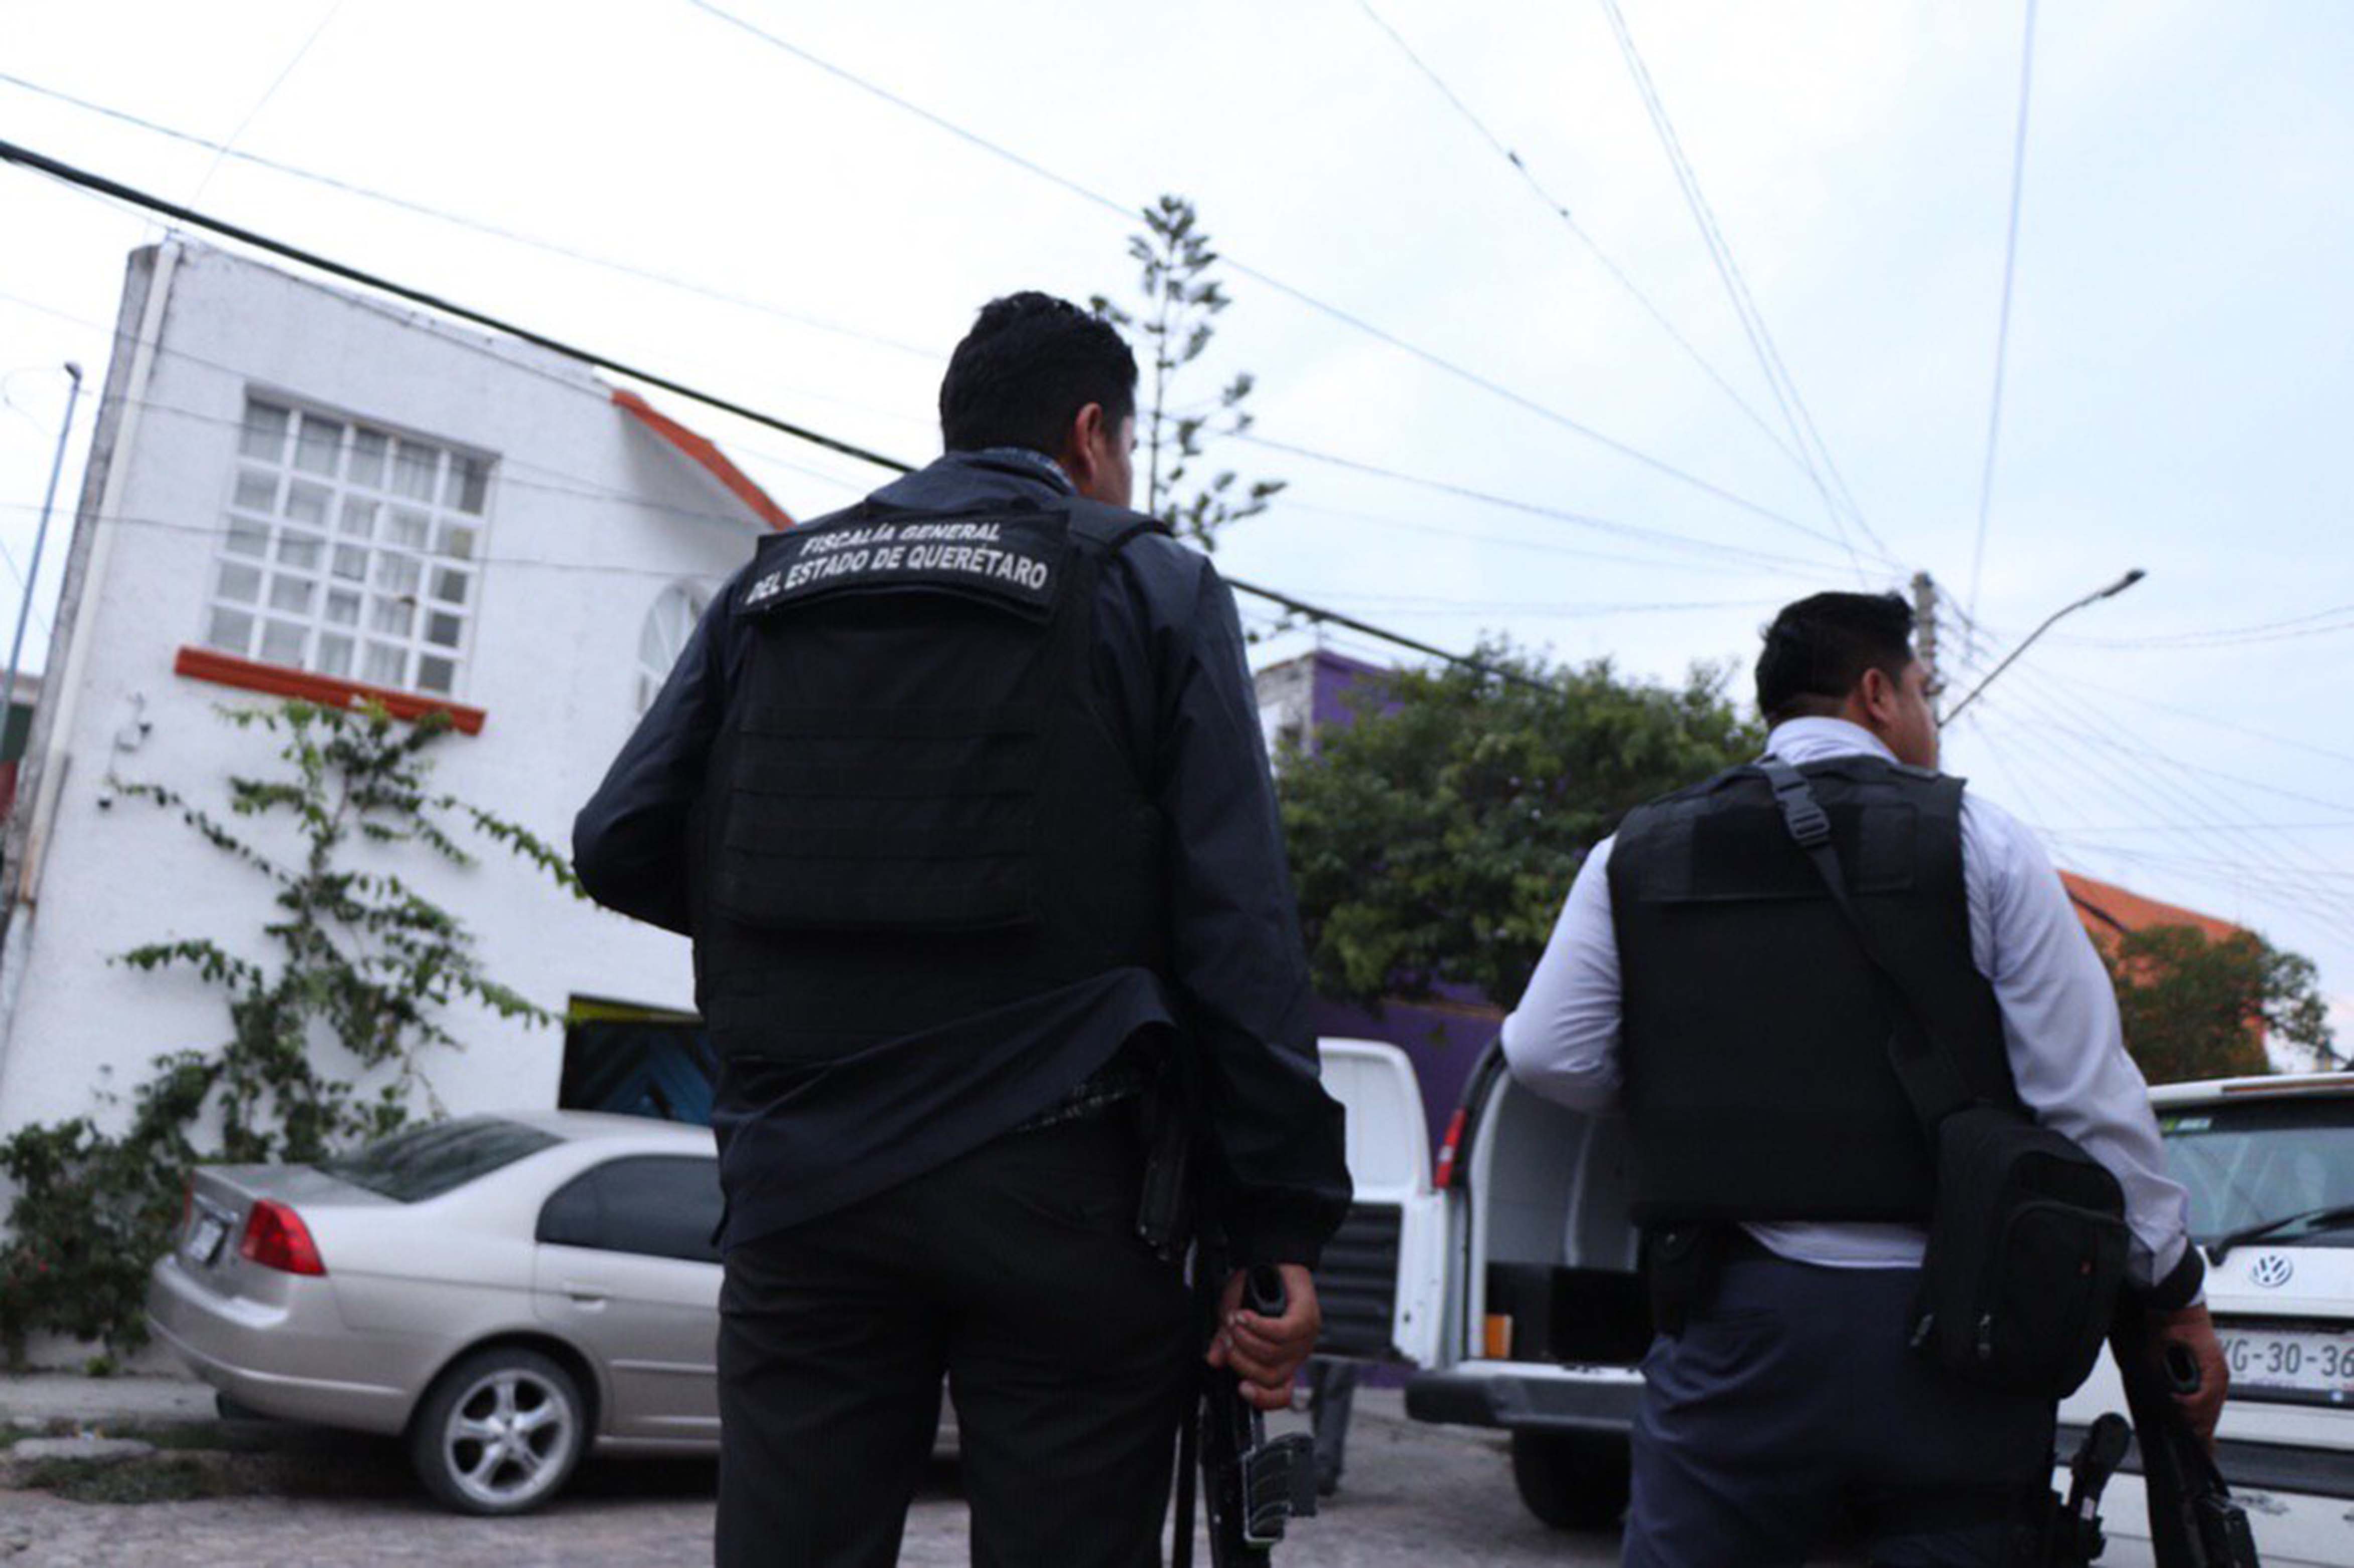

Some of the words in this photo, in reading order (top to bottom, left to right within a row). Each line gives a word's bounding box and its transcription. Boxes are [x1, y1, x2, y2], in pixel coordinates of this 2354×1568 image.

[799, 523, 896, 556] FISCALÍA
[898, 523, 1001, 541] GENERAL
[746, 570, 781, 606] DEL
[784, 549, 870, 591] ESTADO
[870, 545, 906, 571] DE
[907, 543, 1048, 590] QUERÉTARO
